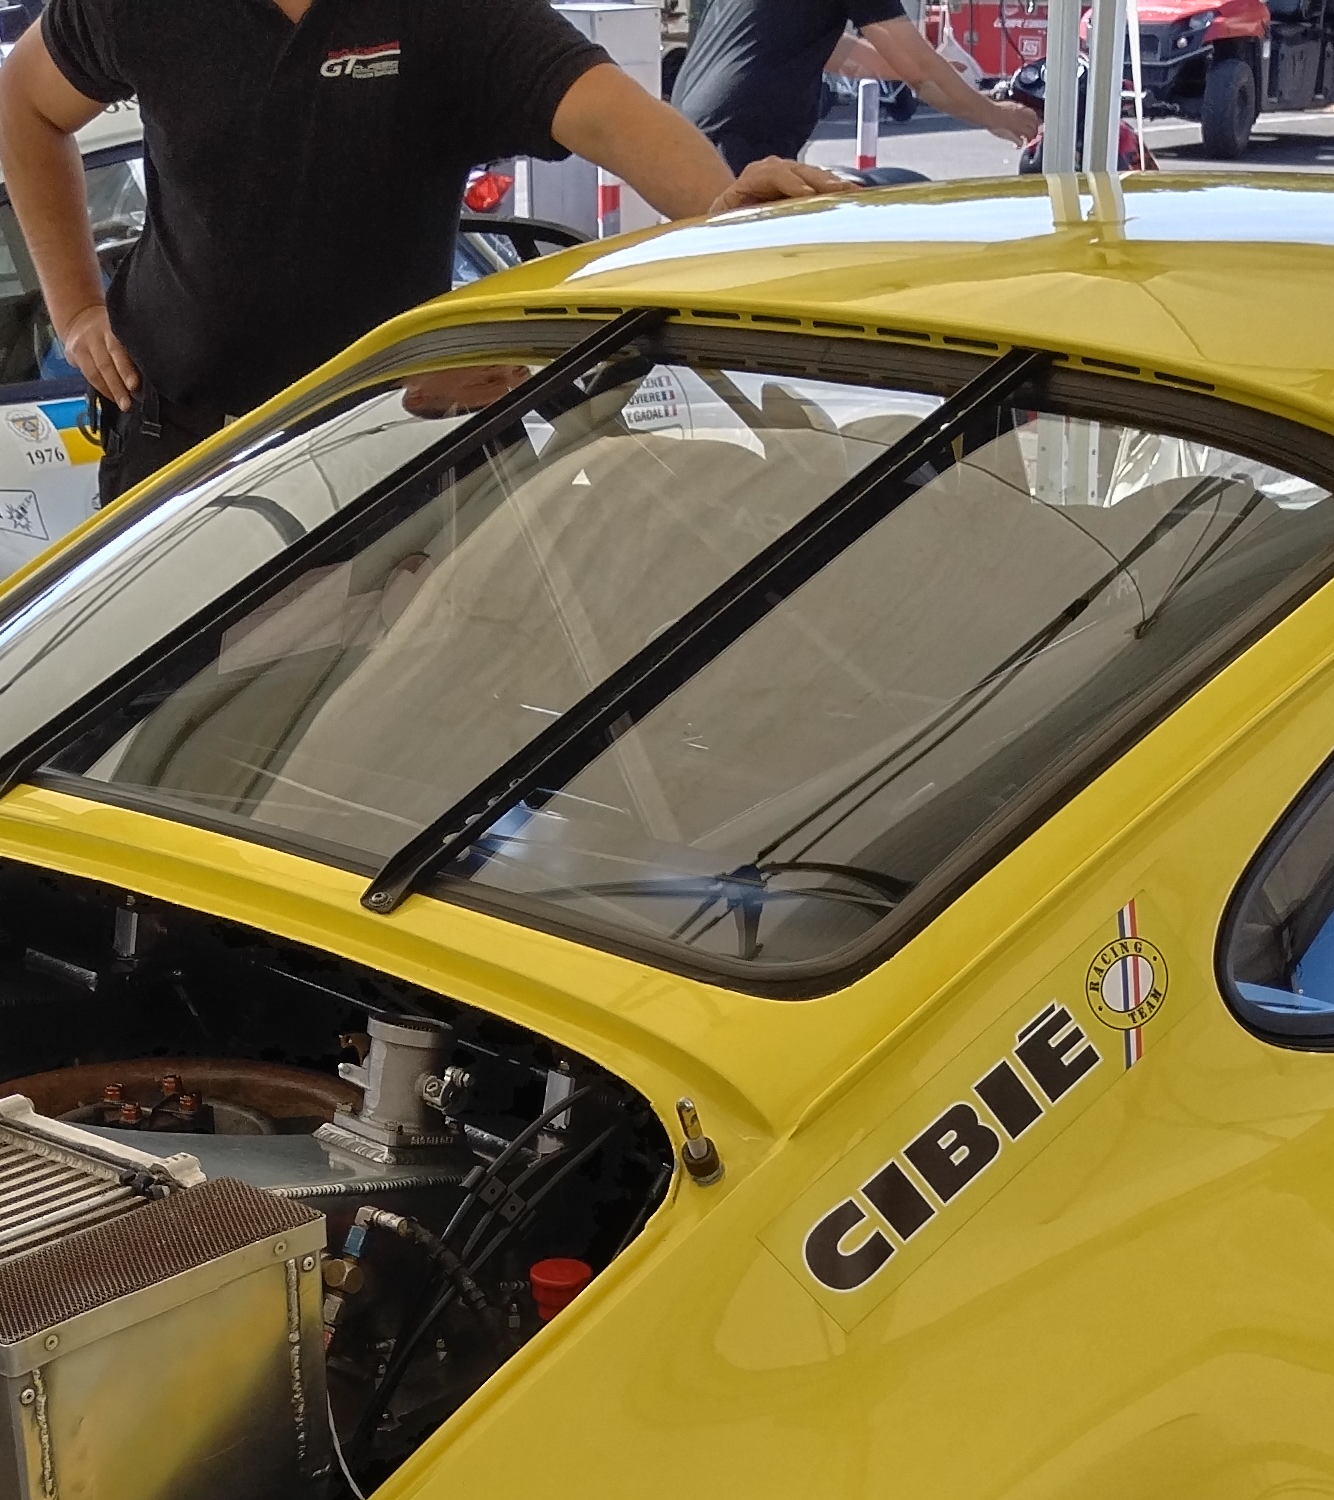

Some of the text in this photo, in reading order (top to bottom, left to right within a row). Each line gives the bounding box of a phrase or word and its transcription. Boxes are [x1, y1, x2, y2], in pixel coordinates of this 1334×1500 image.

[25, 446, 66, 467] 1976
[1088, 940, 1144, 993] RACING
[1127, 987, 1164, 1025] TEAM
[803, 1001, 1103, 1292] CIBIÉ
